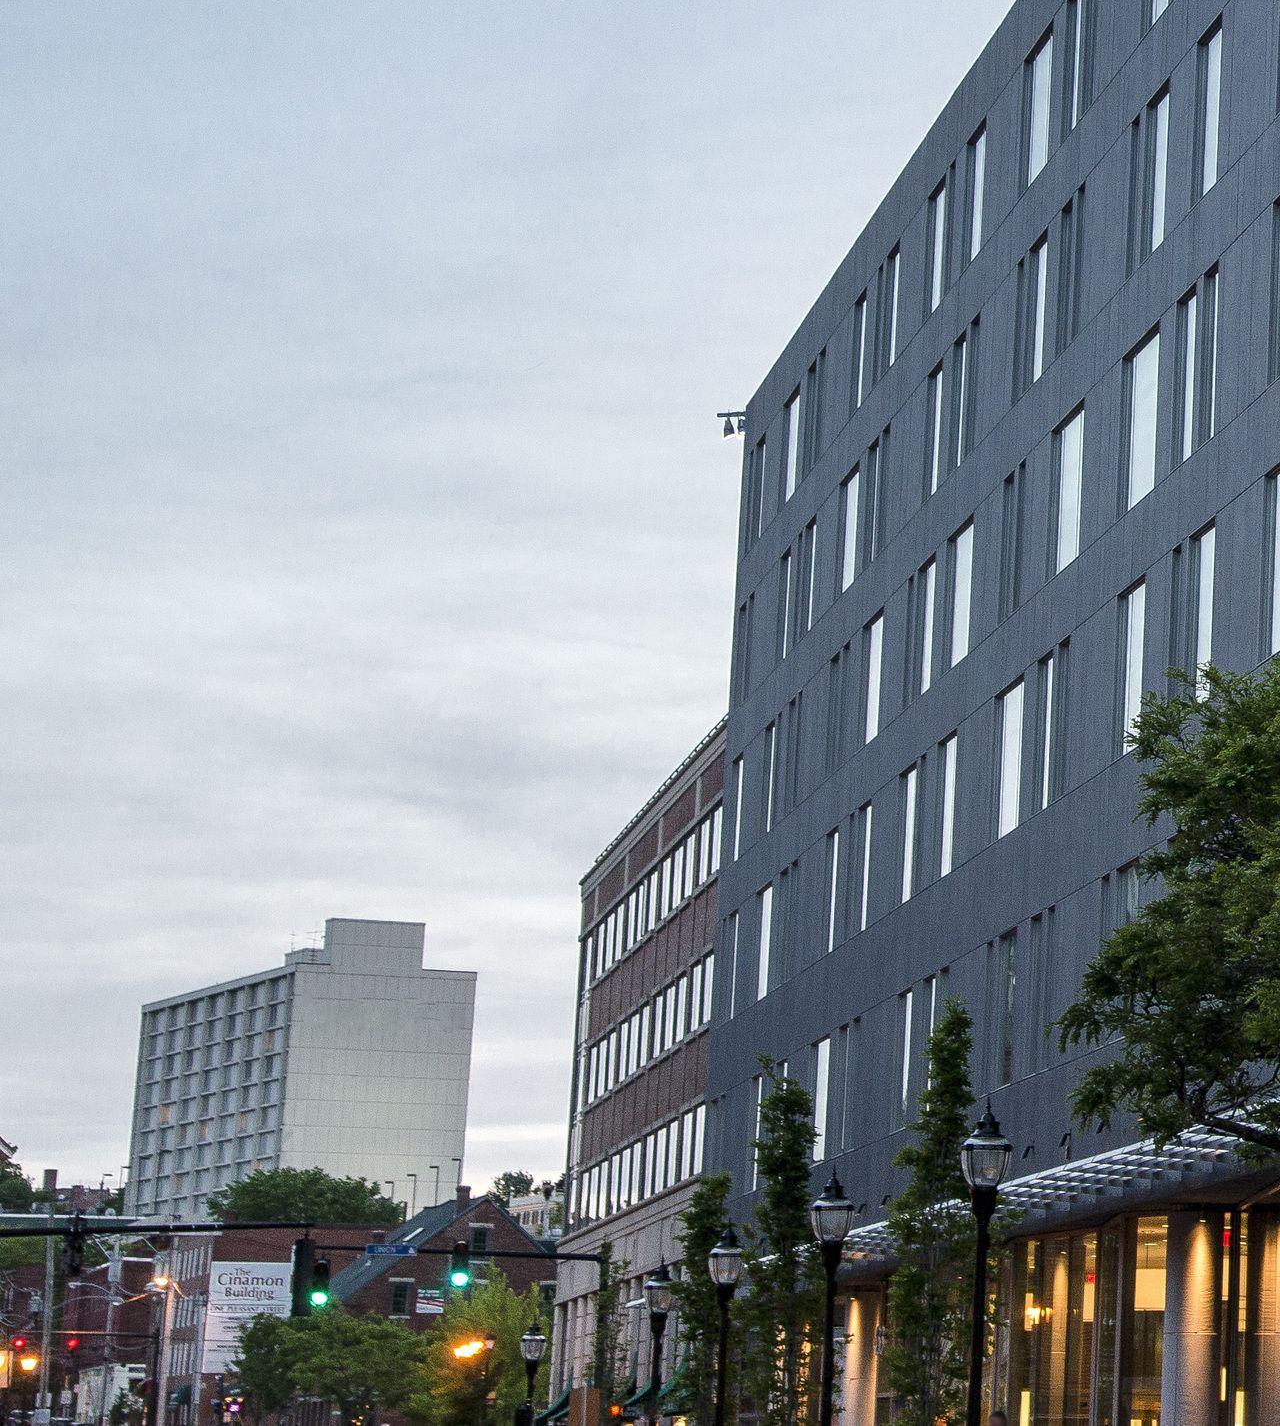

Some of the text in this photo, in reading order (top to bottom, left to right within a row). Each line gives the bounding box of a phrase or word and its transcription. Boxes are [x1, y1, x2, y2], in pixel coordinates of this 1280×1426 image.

[234, 1267, 251, 1276] The
[217, 1272, 284, 1286] Cinamon
[224, 1287, 274, 1301] Building
